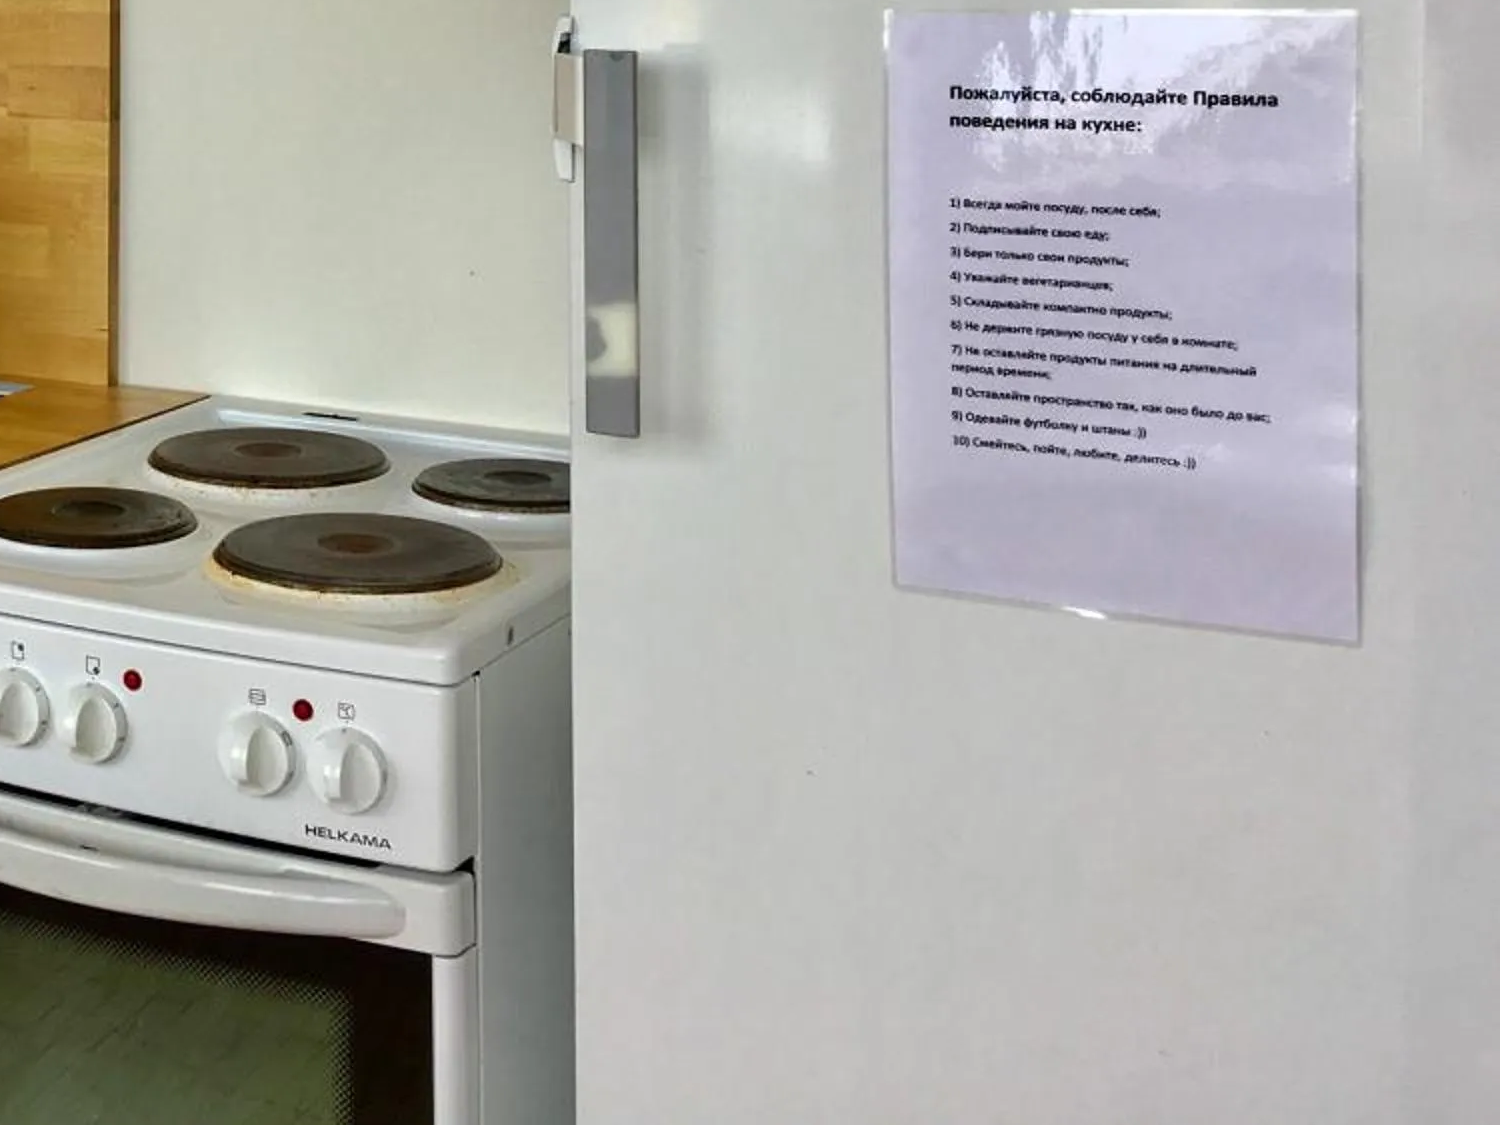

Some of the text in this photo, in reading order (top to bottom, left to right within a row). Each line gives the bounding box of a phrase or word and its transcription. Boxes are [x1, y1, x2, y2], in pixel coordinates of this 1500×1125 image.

[950, 85, 1279, 109] Пожалуйста, соблюдайте Правила
[950, 116, 1142, 134] поведения на кухне:
[949, 198, 960, 209] 1)
[963, 198, 1002, 211] Всегда
[1005, 200, 1040, 211] мойте
[1092, 206, 1126, 216] после
[949, 223, 960, 233] 2)
[950, 295, 961, 307] 5)
[1109, 307, 1173, 320] продукты;
[964, 320, 980, 331] Не
[1087, 331, 1128, 343] посуду
[1131, 334, 1139, 344] у
[1141, 333, 1169, 344] себя
[951, 344, 962, 356] 7)
[964, 346, 980, 355] Не
[1049, 353, 1107, 366] продукты
[1180, 364, 1257, 376] длительный
[965, 387, 1031, 402] Оставляйте
[1033, 395, 1114, 410] пространство
[1141, 405, 1162, 413] как
[1165, 406, 1189, 416] оно
[1191, 405, 1225, 419] было
[1226, 411, 1244, 421] до
[965, 412, 1021, 427] Одевайте
[1023, 417, 1078, 433] футболку
[1081, 424, 1089, 432] и
[953, 435, 970, 448] 10)
[1033, 444, 1071, 458] пойте,
[1124, 454, 1180, 467] делитесь
[305, 824, 392, 850] HELKAMA
